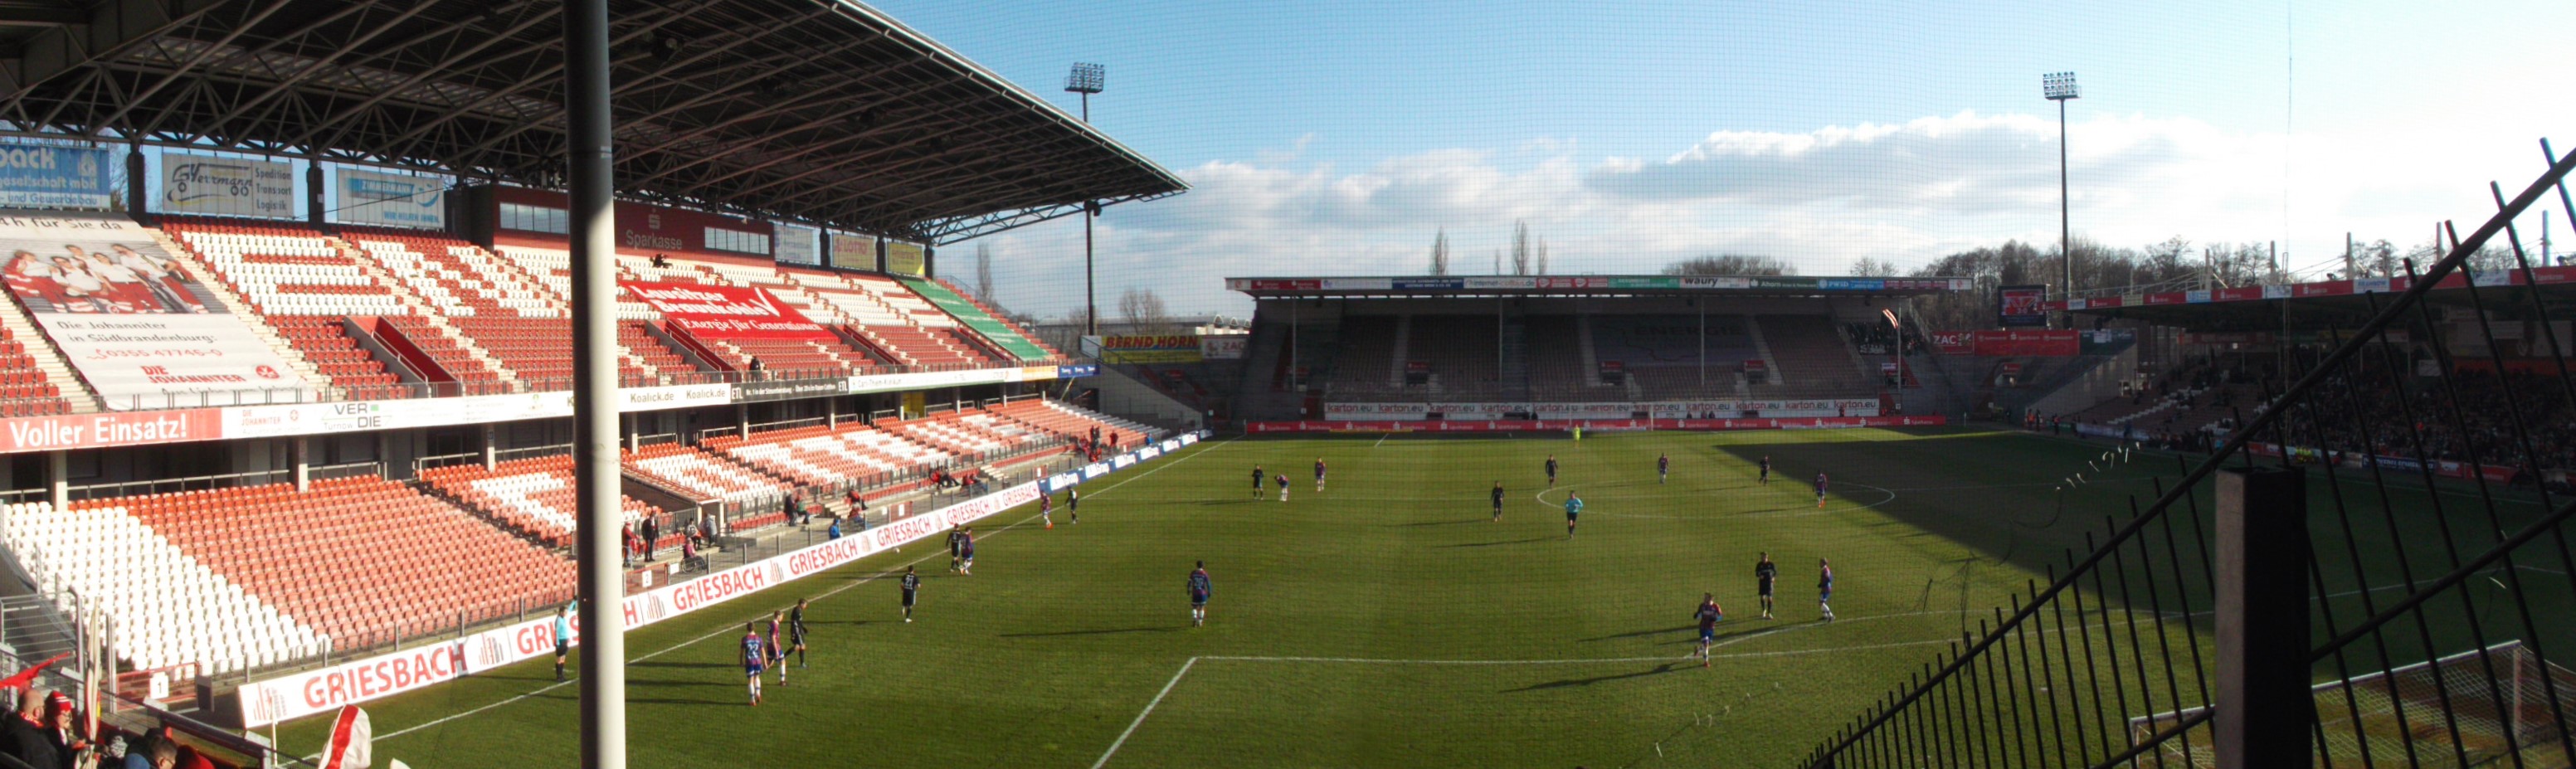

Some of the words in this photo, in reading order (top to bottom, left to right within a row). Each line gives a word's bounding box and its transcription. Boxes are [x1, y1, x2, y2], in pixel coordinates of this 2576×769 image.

[256, 168, 290, 180] Spedition
[256, 183, 290, 196] Transport
[257, 200, 286, 212] Logistik
[64, 218, 95, 229] Sie
[100, 219, 123, 230] da
[626, 229, 683, 250] Sparkasse
[1685, 277, 1719, 287] waury
[629, 285, 728, 302] Lausitzer
[650, 299, 771, 316] Braunkohle
[57, 321, 78, 329] Die
[88, 320, 167, 330] Johanniter
[679, 318, 730, 331] Energie
[731, 319, 750, 331] für
[751, 320, 824, 331] Generationen
[69, 333, 80, 343] in
[94, 333, 217, 343] Südbrandenburg:
[1105, 337, 1154, 348] BERND
[1157, 335, 1198, 348] HORN
[1933, 335, 1957, 344] ZAC
[140, 365, 169, 375] DIE
[149, 374, 246, 384] JOHANNITER
[731, 387, 743, 399] ETL
[838, 380, 848, 392] ETL
[334, 403, 368, 415] VER
[1327, 403, 1372, 412] karton.eu
[1378, 403, 1424, 412] karton.eu
[1429, 403, 1475, 412] karton.eu
[1481, 403, 1527, 412] karton.eu
[1686, 402, 1731, 411] karton.eu
[1736, 402, 1780, 410] karton.eu
[1785, 401, 1828, 409] karton.eu
[1833, 400, 1877, 409] karton.eu
[358, 416, 382, 428] DIE
[9, 420, 84, 448] Voller
[94, 412, 187, 443] Einsatz!
[947, 499, 990, 525] GRIESBACH
[877, 517, 932, 546] GRIESBACH
[789, 539, 858, 575] GRIESBACH
[673, 568, 764, 611] GRIESBACH
[304, 642, 468, 708] GRIESBACH
[157, 681, 163, 694] 1
